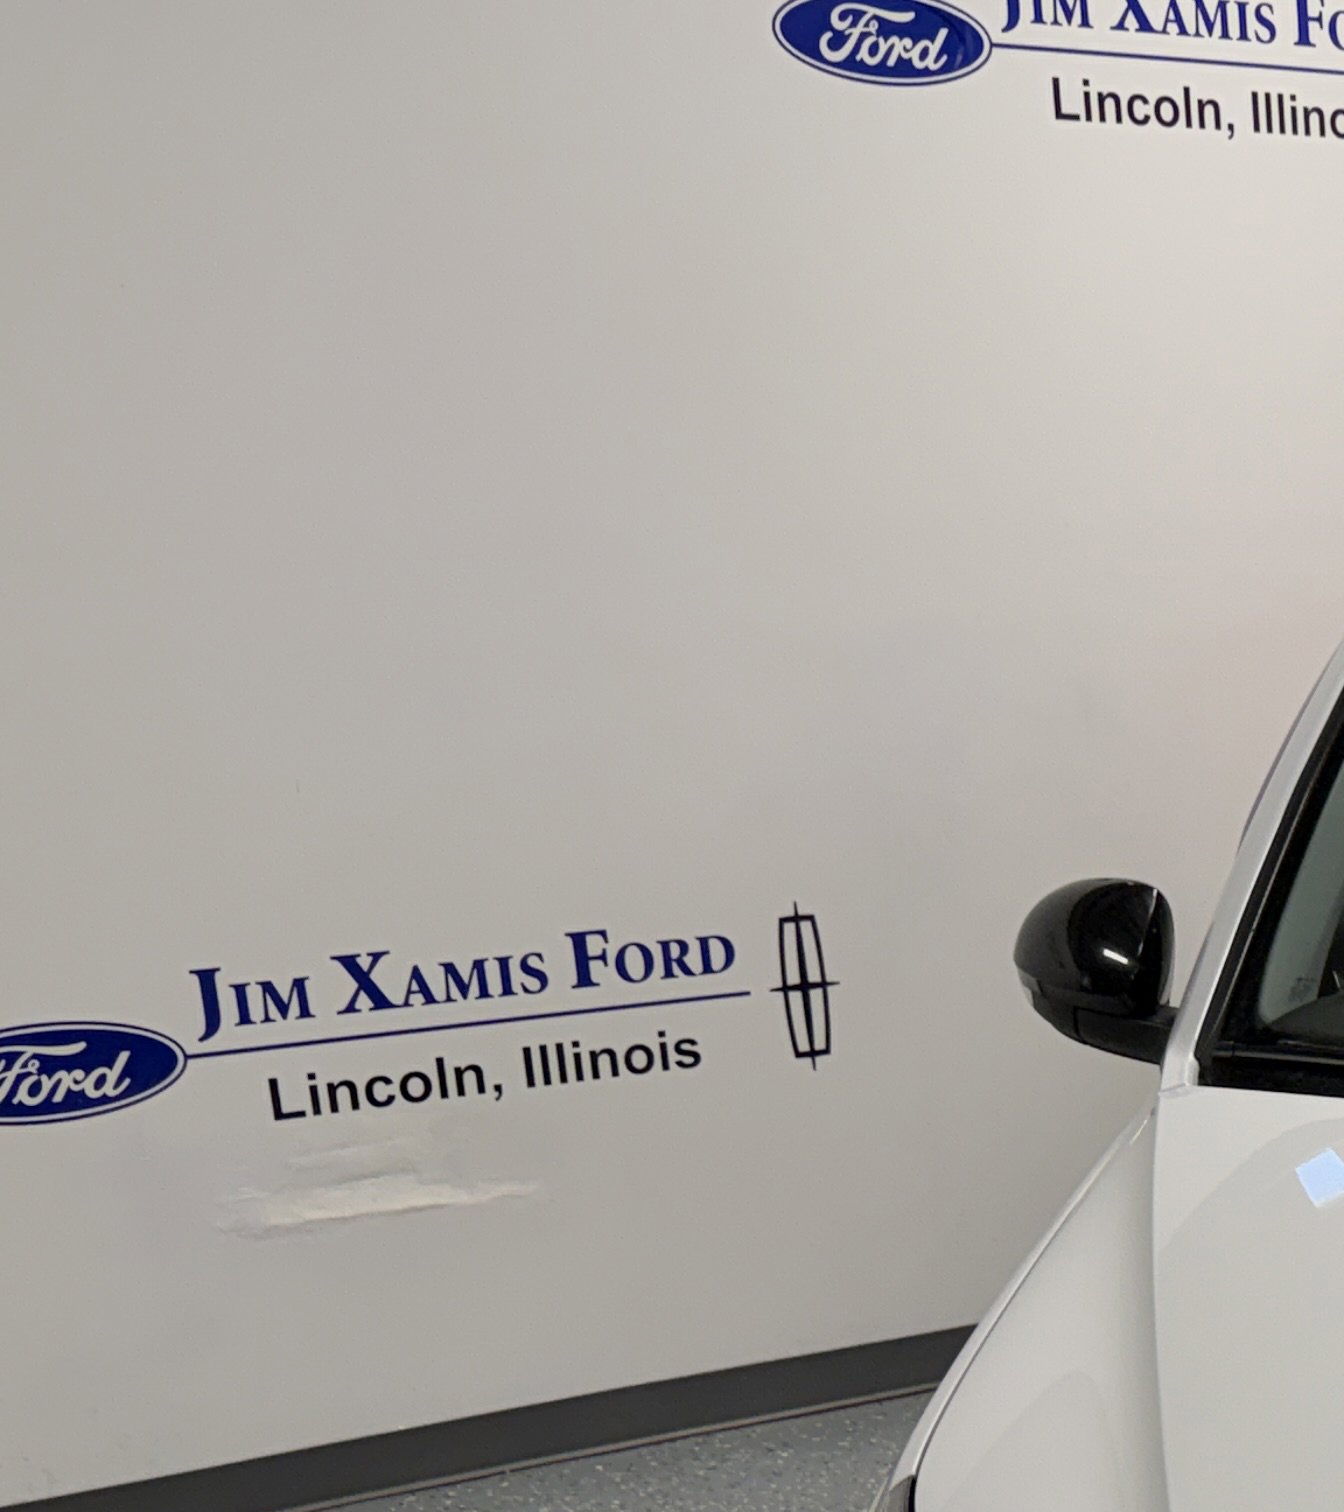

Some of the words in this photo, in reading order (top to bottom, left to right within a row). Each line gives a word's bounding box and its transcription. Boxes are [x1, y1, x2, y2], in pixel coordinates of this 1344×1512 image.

[819, 2, 948, 71] Ford
[1051, 77, 1235, 139] Lincoln,
[189, 966, 316, 1042] JIM
[330, 950, 549, 1017] XAMIS
[565, 929, 736, 989] FORD
[267, 1056, 504, 1122] Lincoln,
[522, 1031, 702, 1088] Illinois
